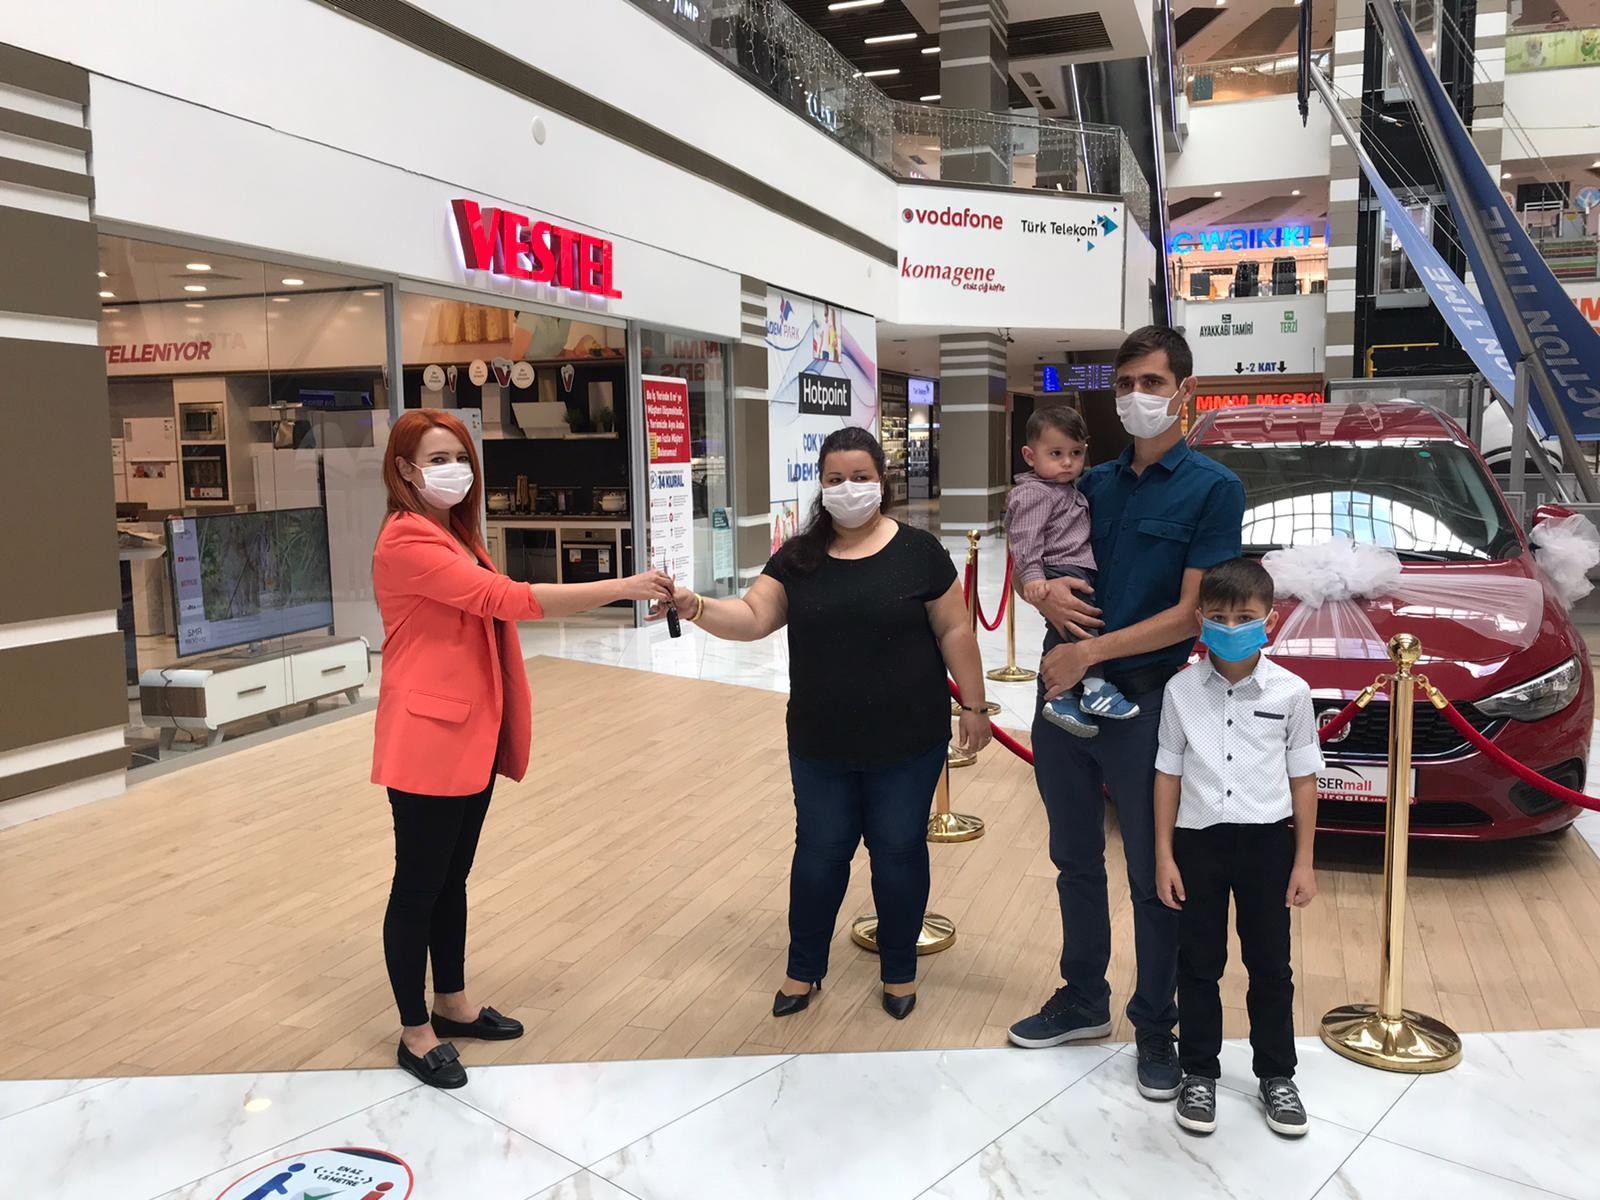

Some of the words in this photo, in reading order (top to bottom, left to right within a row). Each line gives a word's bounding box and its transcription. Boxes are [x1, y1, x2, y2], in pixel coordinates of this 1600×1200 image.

[916, 207, 1003, 230] vodafone
[1021, 220, 1047, 234] Türk
[1050, 222, 1098, 237] Telekom
[451, 199, 622, 299] VESTEL
[902, 257, 995, 286] komagene
[1423, 266, 1484, 330] TIME
[1199, 325, 1231, 337] AYAKKABI
[1232, 321, 1254, 336] TAMİRİ
[1280, 320, 1298, 333] TERZİ
[1245, 362, 1255, 373] -2
[1258, 362, 1277, 373] KAT
[804, 378, 848, 411] Hotpoint
[328, 1177, 359, 1187] METRE
